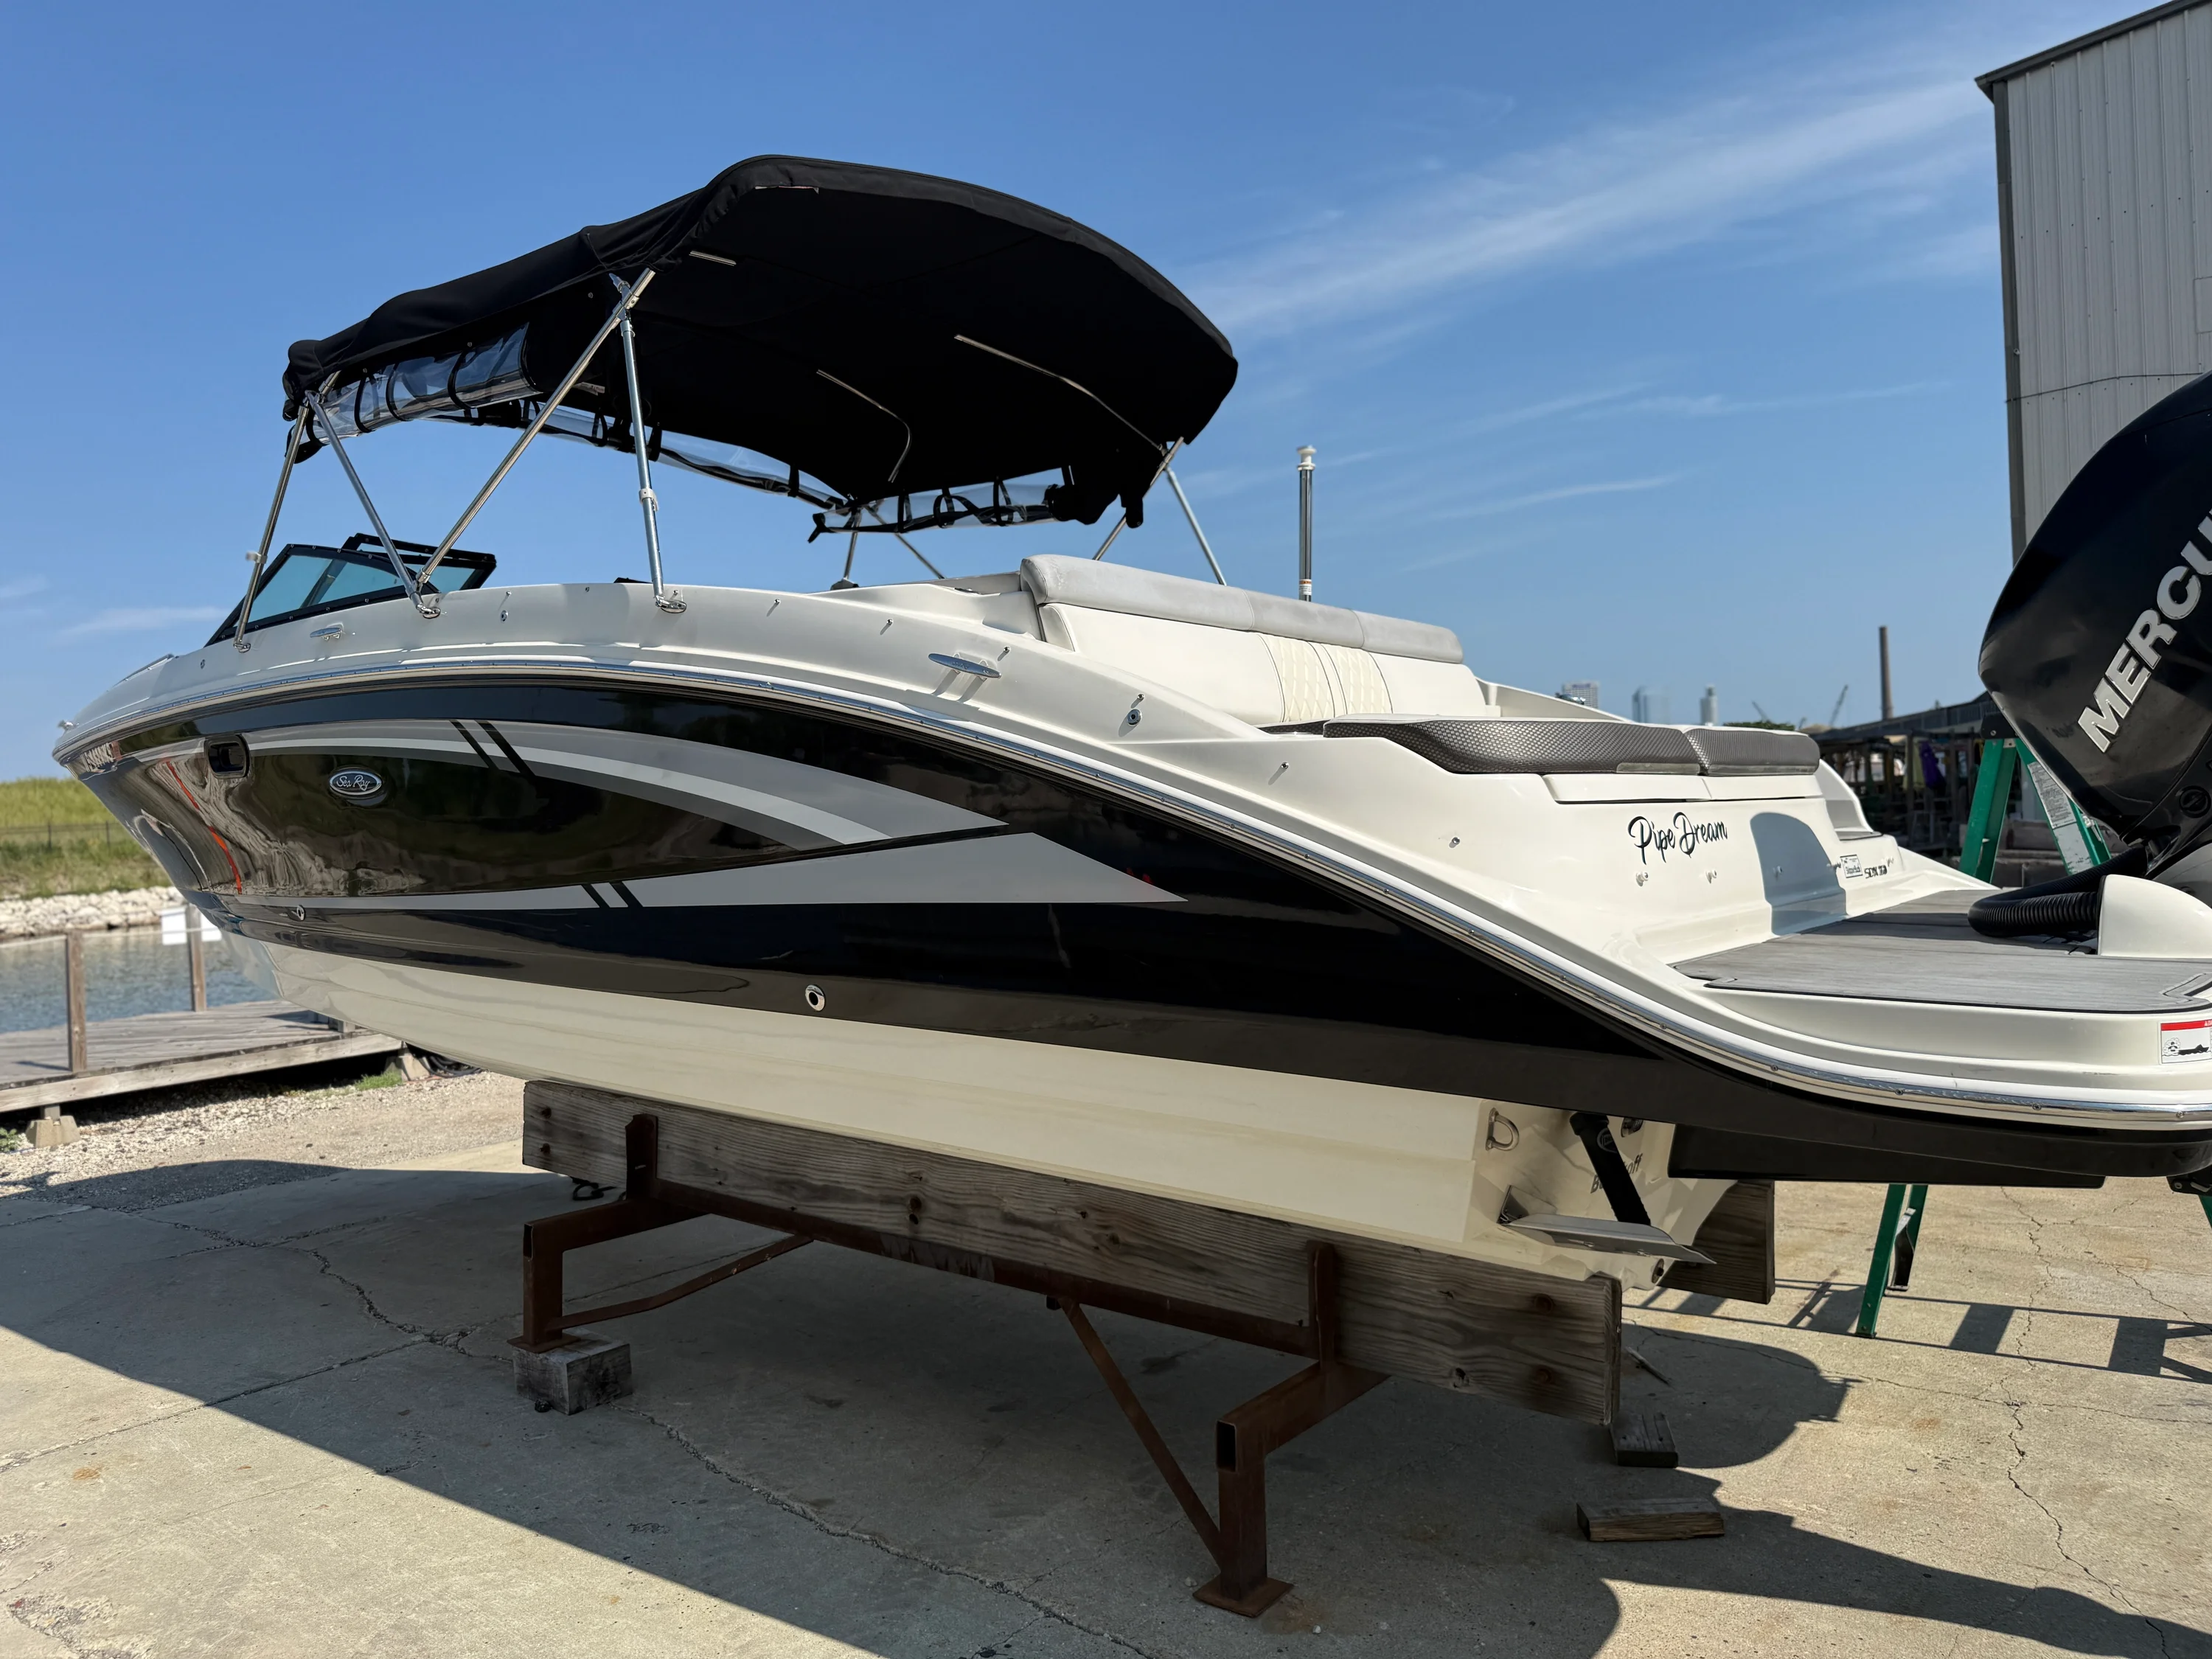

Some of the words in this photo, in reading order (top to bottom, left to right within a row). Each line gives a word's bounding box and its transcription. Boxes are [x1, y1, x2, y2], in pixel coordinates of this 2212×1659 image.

[2078, 508, 2212, 753] MERCU
[336, 776, 352, 787] Sea
[353, 774, 370, 791] Ray
[1627, 815, 1676, 866] Pipe
[1673, 811, 1728, 858] Dream
